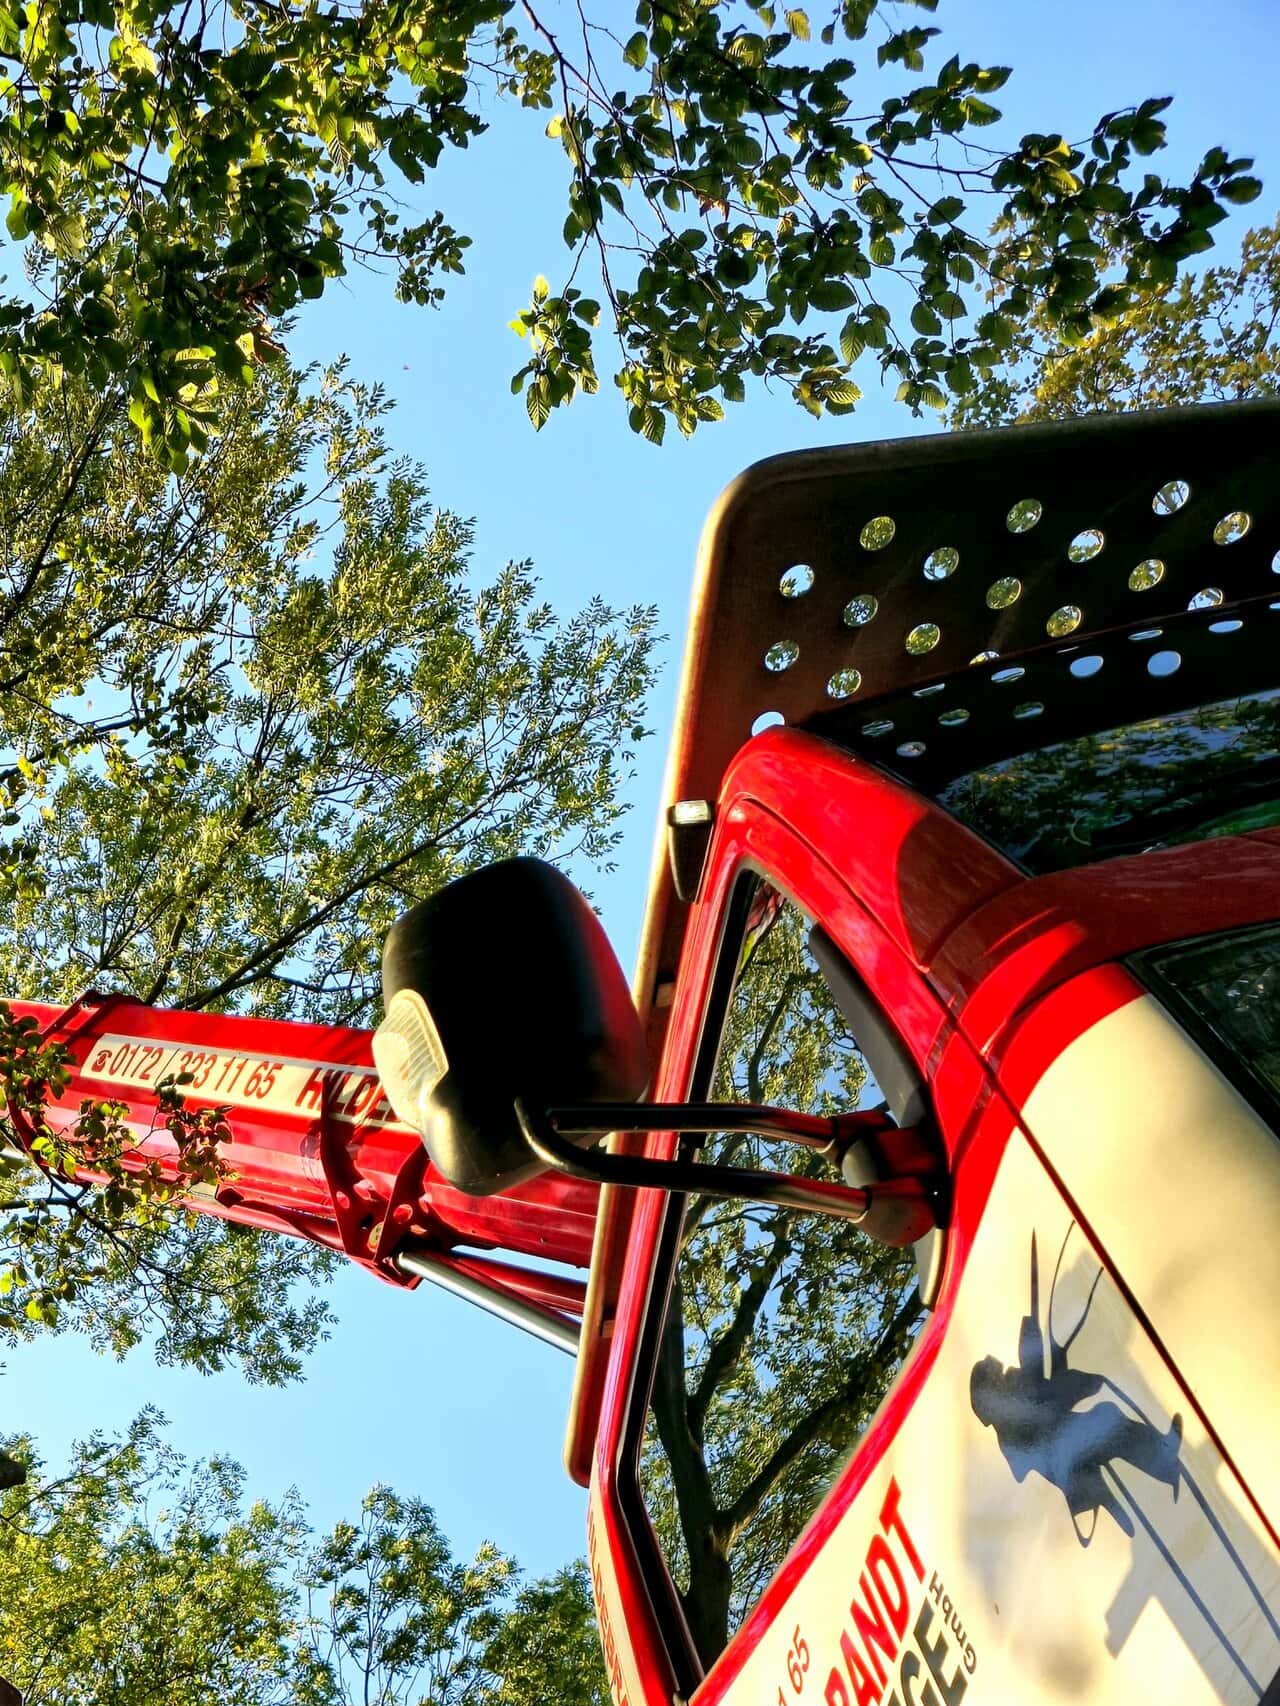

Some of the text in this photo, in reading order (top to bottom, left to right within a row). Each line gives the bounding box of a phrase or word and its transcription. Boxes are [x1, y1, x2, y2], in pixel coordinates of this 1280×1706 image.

[108, 1043, 164, 1080] 0172
[215, 1056, 249, 1093] 11
[243, 1061, 285, 1099] 65
[928, 1569, 977, 1675] GmbH
[787, 1623, 811, 1695] 65
